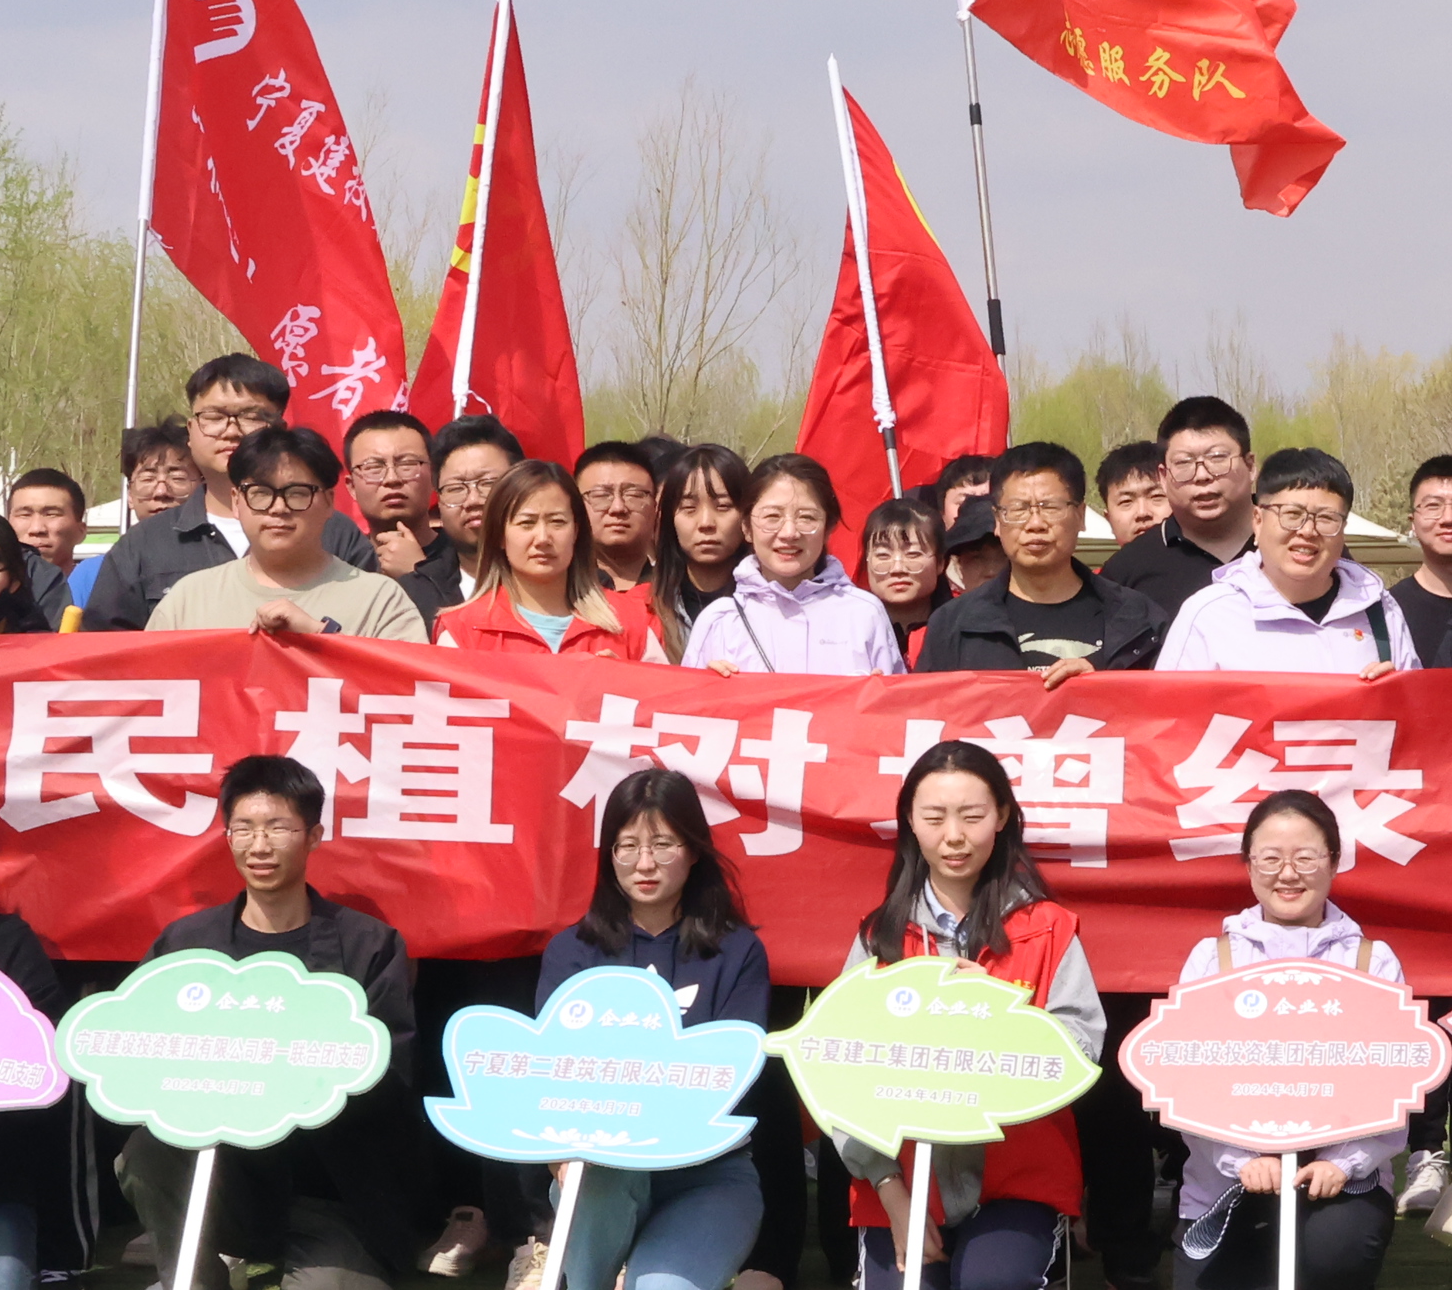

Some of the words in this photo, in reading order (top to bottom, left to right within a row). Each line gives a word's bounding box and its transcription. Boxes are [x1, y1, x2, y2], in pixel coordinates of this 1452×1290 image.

[215, 992, 287, 1013] 企业林
[926, 997, 993, 1020] 企业林
[1272, 997, 1344, 1016] 企业林
[598, 1009, 662, 1030] 企业林
[76, 1030, 368, 1069] 宁夏建设投资集团有限公司第一联合团支部
[800, 1037, 1063, 1081] 宁夏建工集团有限公司团委
[1141, 1040, 1430, 1067] 宁夏建设投资集团有限公司团委
[464, 1050, 735, 1091] 宁夏第二建筑有限公司团委
[162, 1078, 265, 1096] 2024年4月7日
[875, 1086, 978, 1105] 2024年4月7日
[1232, 1083, 1334, 1097] 2024年4月7日
[540, 1097, 641, 1117] 2024年4月7日
